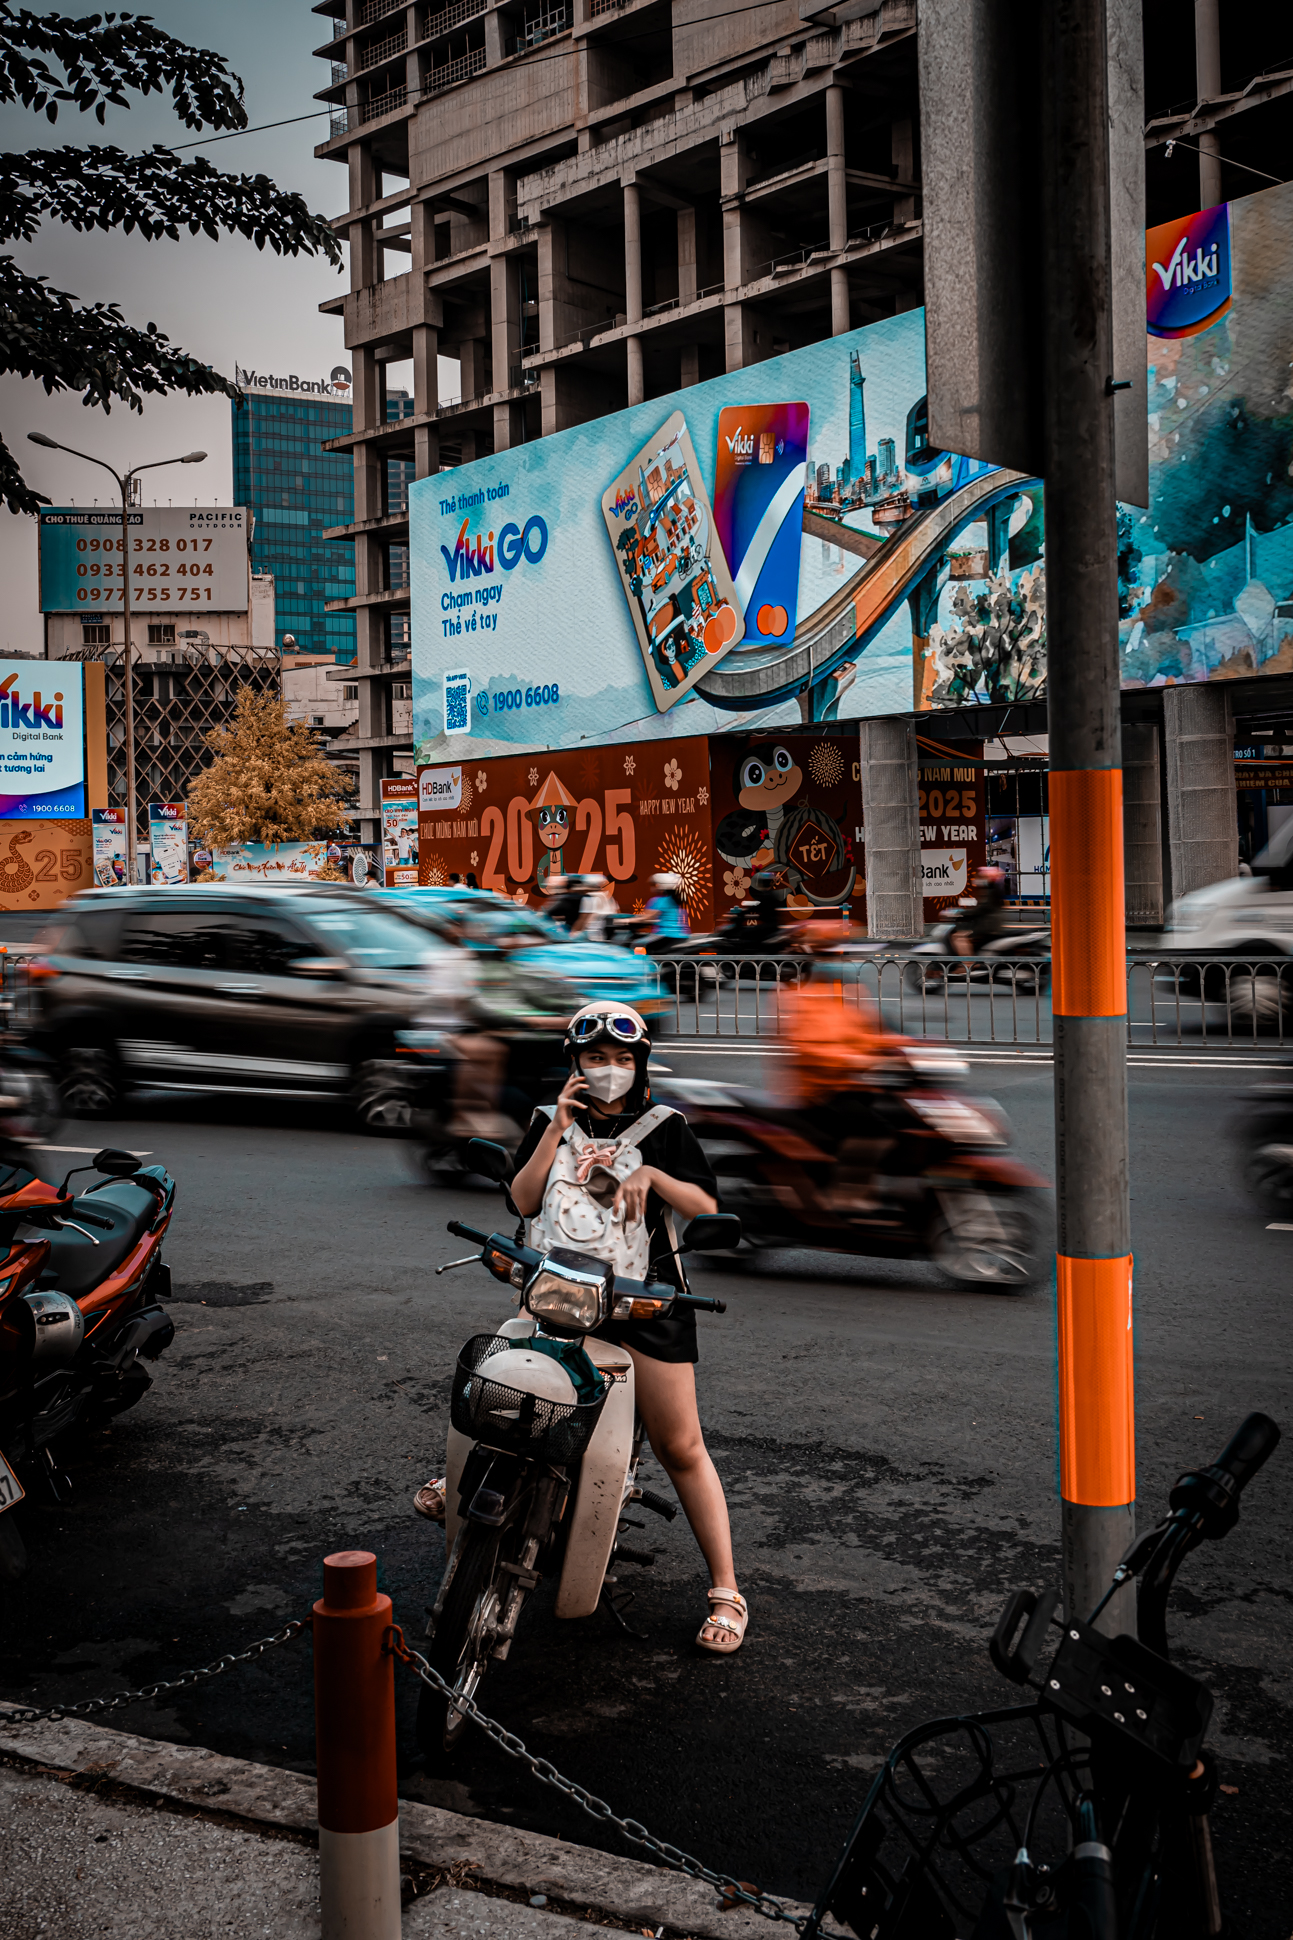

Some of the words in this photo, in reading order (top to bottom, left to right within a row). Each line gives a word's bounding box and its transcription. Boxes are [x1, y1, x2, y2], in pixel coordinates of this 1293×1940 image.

[1152, 237, 1218, 290] Vikki
[242, 369, 332, 395] VietinBank
[725, 426, 754, 454] Vikki
[439, 496, 456, 516] Thẻ
[458, 488, 485, 510] thanh
[486, 481, 510, 501] toán
[609, 484, 635, 518] Vikki
[46, 515, 64, 523] CHO
[65, 514, 90, 523] THUÊ
[91, 513, 122, 524] QUẢNG
[190, 513, 242, 521] PACIFIC
[625, 502, 638, 521] GO
[76, 538, 124, 551] 0908
[133, 538, 170, 551] 328
[176, 538, 213, 551] 017
[441, 517, 494, 582] Vikki
[497, 515, 548, 571] GO
[76, 563, 124, 576] 0933
[133, 563, 170, 576] 462
[176, 563, 214, 576] 404
[76, 588, 124, 601] 0977
[134, 588, 170, 601] 755
[177, 588, 212, 601] 751
[441, 591, 473, 612] Chạm
[475, 584, 502, 606] ngay
[442, 616, 461, 637] Thẻ
[465, 610, 477, 633] về
[480, 613, 497, 631] tay
[492, 689, 522, 713] 1900
[525, 683, 560, 707] 6608
[12, 732, 40, 742] Digital
[43, 733, 63, 741] Bank
[7, 751, 27, 761] cảm
[29, 752, 53, 762] hứng
[1252, 749, 1255, 757] 1
[4, 765, 31, 774] tương
[34, 764, 45, 772] lai
[422, 781, 452, 795] HDBank
[158, 805, 176, 816] Vikki
[639, 800, 660, 816] HAPPY
[662, 799, 676, 814] NEW
[677, 798, 695, 814] YEAR
[919, 790, 976, 818] 2025
[100, 810, 117, 820] Vikki
[386, 819, 398, 827] 50
[421, 820, 434, 839] CHÚC
[436, 820, 451, 838] MỪNG
[453, 819, 466, 838] NĂM
[941, 825, 977, 840] YEAR
[799, 836, 827, 862] TẾT
[921, 864, 949, 879] Bank
